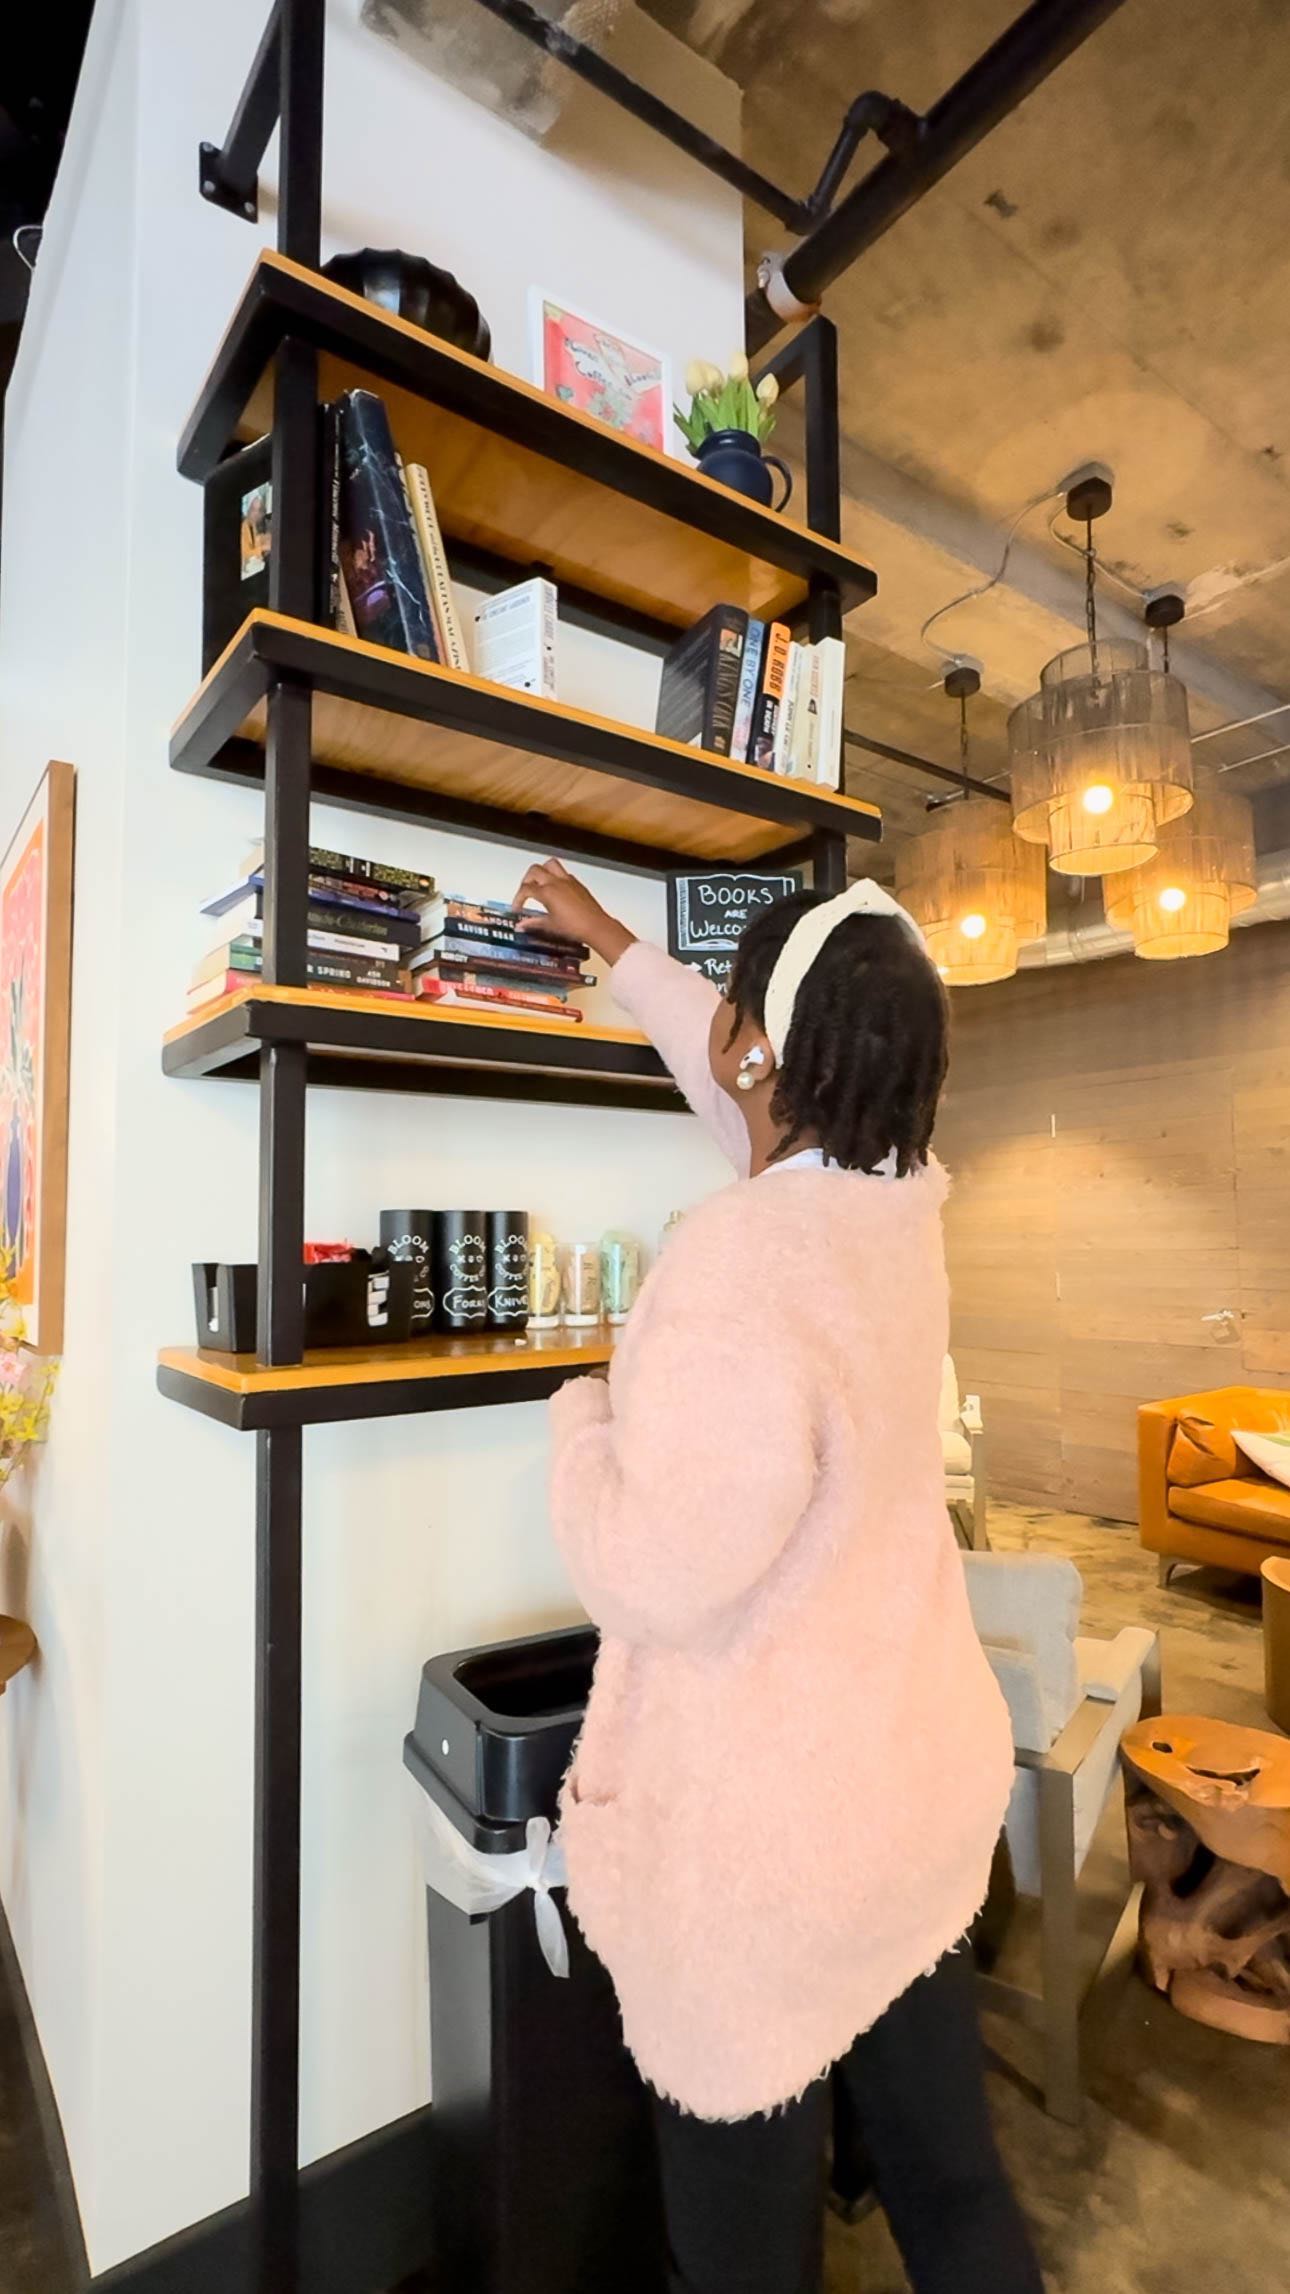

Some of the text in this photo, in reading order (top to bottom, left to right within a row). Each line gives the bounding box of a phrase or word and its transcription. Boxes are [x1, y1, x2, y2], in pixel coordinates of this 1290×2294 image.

[746, 627, 762, 657] ONE
[775, 633, 789, 643] J.
[745, 660, 756, 675] BY
[769, 659, 785, 692] ROBB
[742, 679, 754, 708] ONE
[698, 885, 774, 905] BOOKS
[724, 909, 747, 919] ARE
[458, 923, 514, 941] SAVING NOAH
[317, 966, 351, 979] SPRING
[356, 976, 391, 987] DAVIDSON
[387, 1234, 429, 1255] BLOOM
